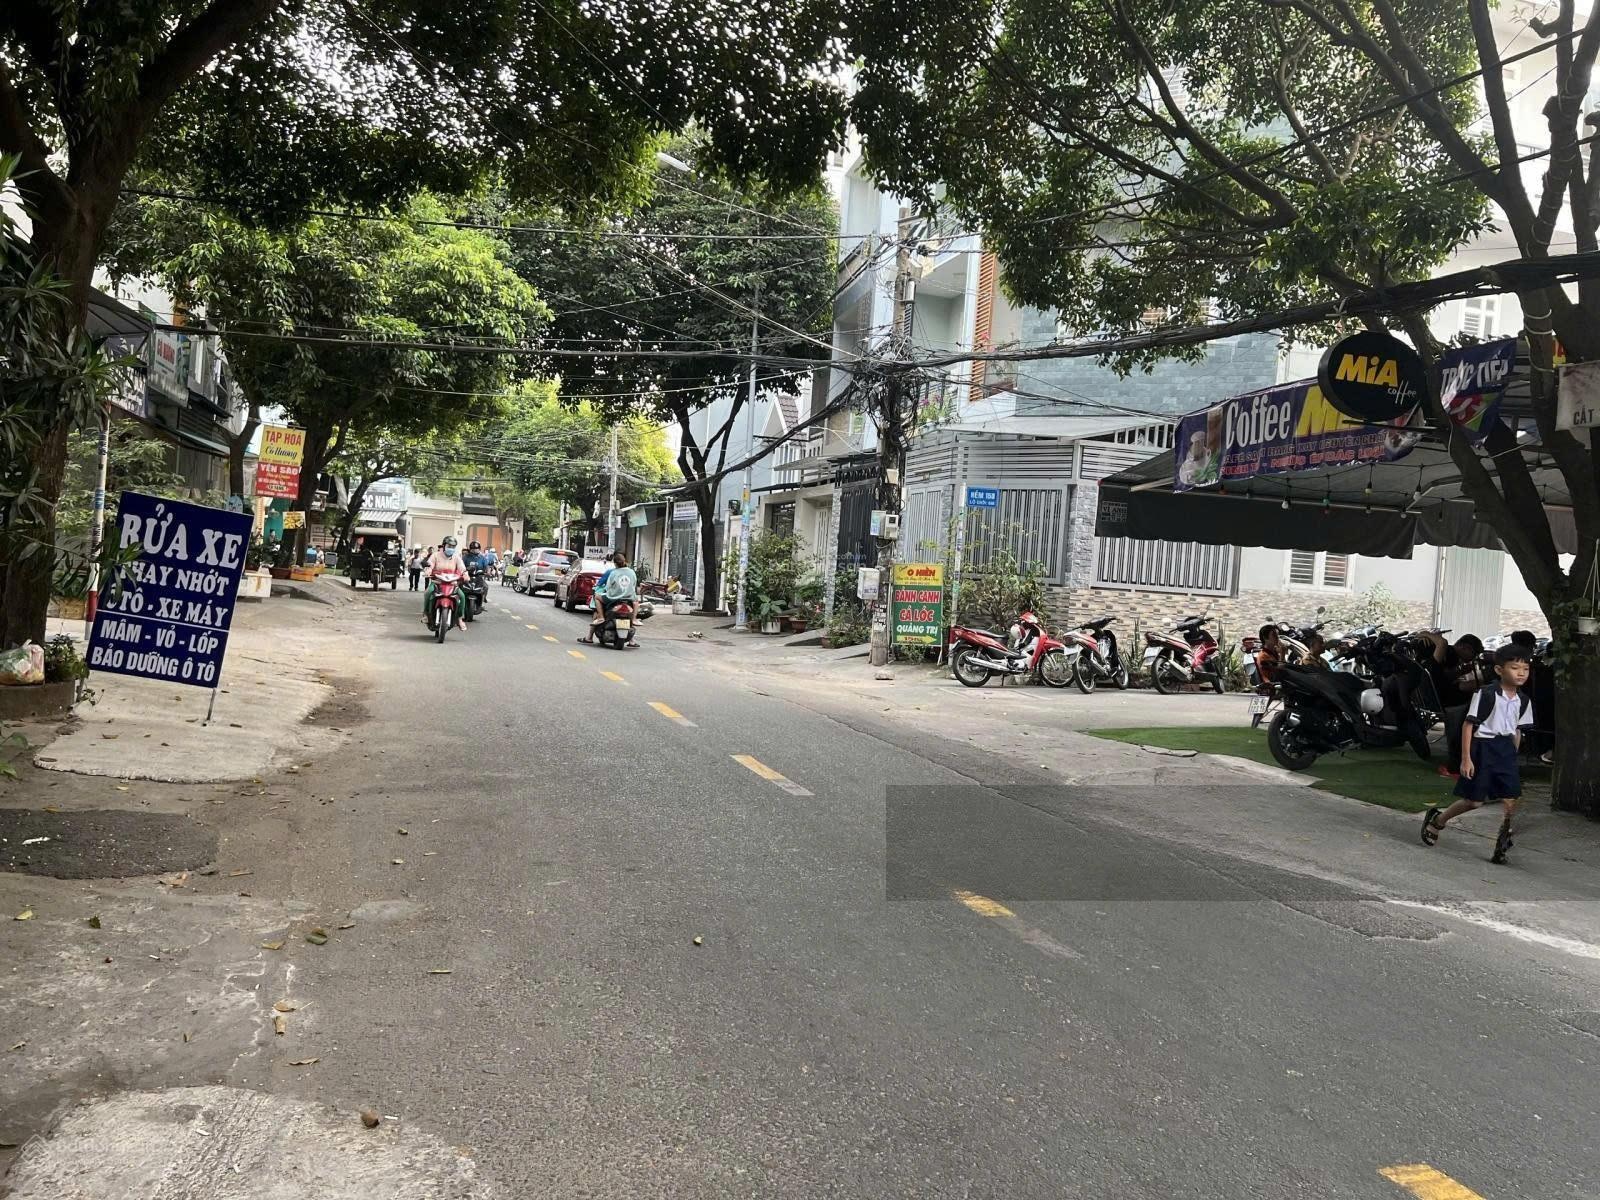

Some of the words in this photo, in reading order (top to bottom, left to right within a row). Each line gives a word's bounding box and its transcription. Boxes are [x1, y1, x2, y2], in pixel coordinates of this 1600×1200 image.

[1335, 354, 1398, 387] MiA
[1387, 380, 1417, 405] coffee
[1226, 395, 1291, 449] Coffee
[119, 503, 189, 560] RỬA
[196, 529, 243, 570] XE
[174, 568, 230, 597] NHỚT
[155, 597, 183, 620] XE
[185, 599, 229, 628] MÁY
[100, 618, 143, 644] MÂM
[156, 625, 177, 649] VỎ
[188, 630, 219, 655] LỐP
[91, 642, 124, 668] BẢO
[126, 651, 180, 677] DƯỠNG
[181, 656, 194, 679] Ô
[196, 660, 216, 682] TÔ
